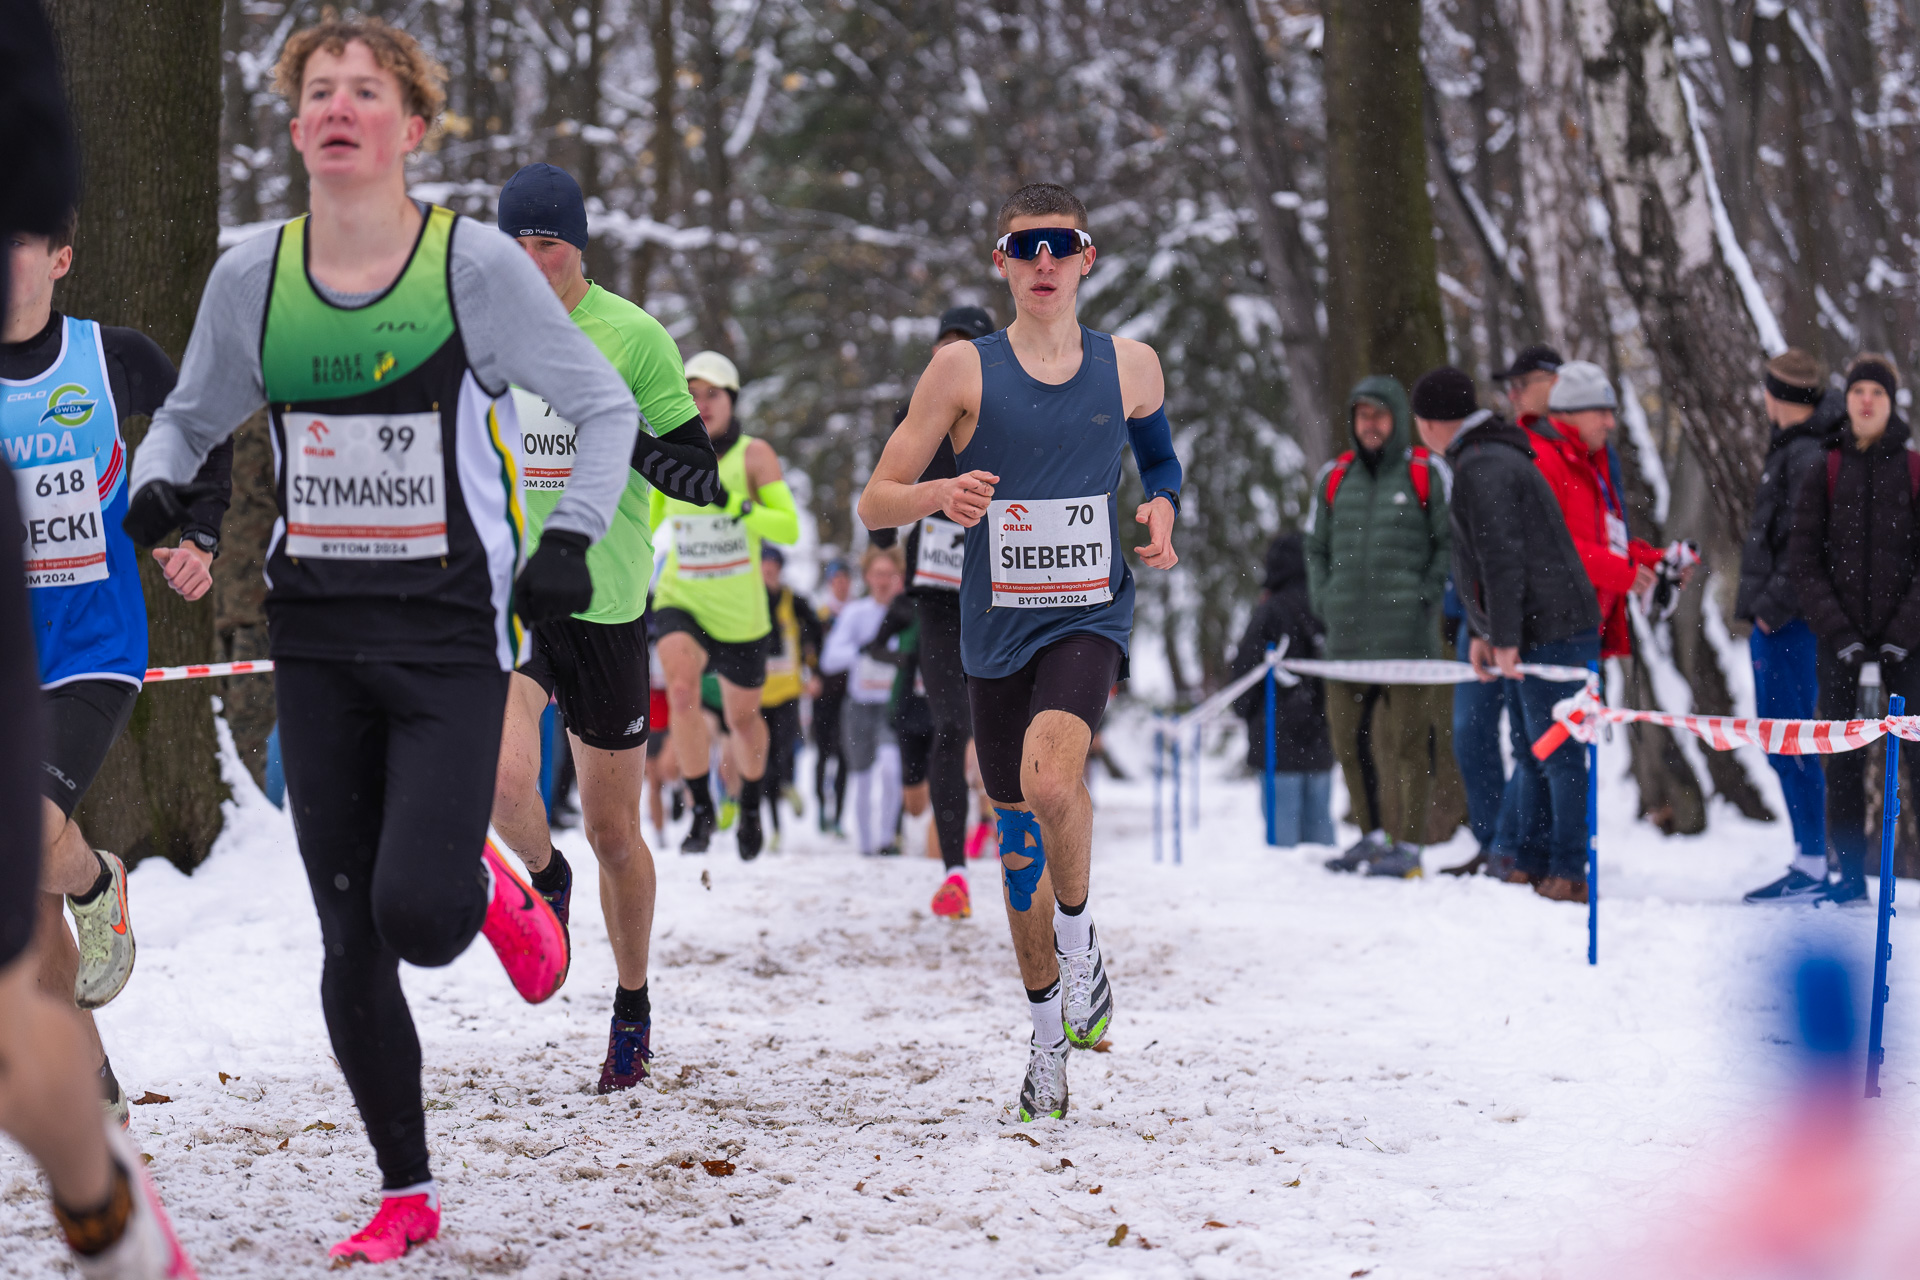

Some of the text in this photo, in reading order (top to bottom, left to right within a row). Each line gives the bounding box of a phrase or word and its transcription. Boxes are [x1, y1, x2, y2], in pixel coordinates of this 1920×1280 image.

[54, 406, 82, 414] GWDA
[0, 431, 77, 463] WDA
[378, 426, 415, 453] 99
[36, 469, 85, 497] 618
[293, 469, 435, 507] SZYMAŃSKI
[540, 480, 565, 488] 2024
[1065, 504, 1094, 526] 70
[1003, 524, 1032, 532] ORLEN
[321, 543, 408, 554] BYTOM 2024
[1001, 542, 1101, 569] SIEBERT
[43, 573, 75, 582] 2024
[1019, 595, 1087, 605] BYTOM 2024
